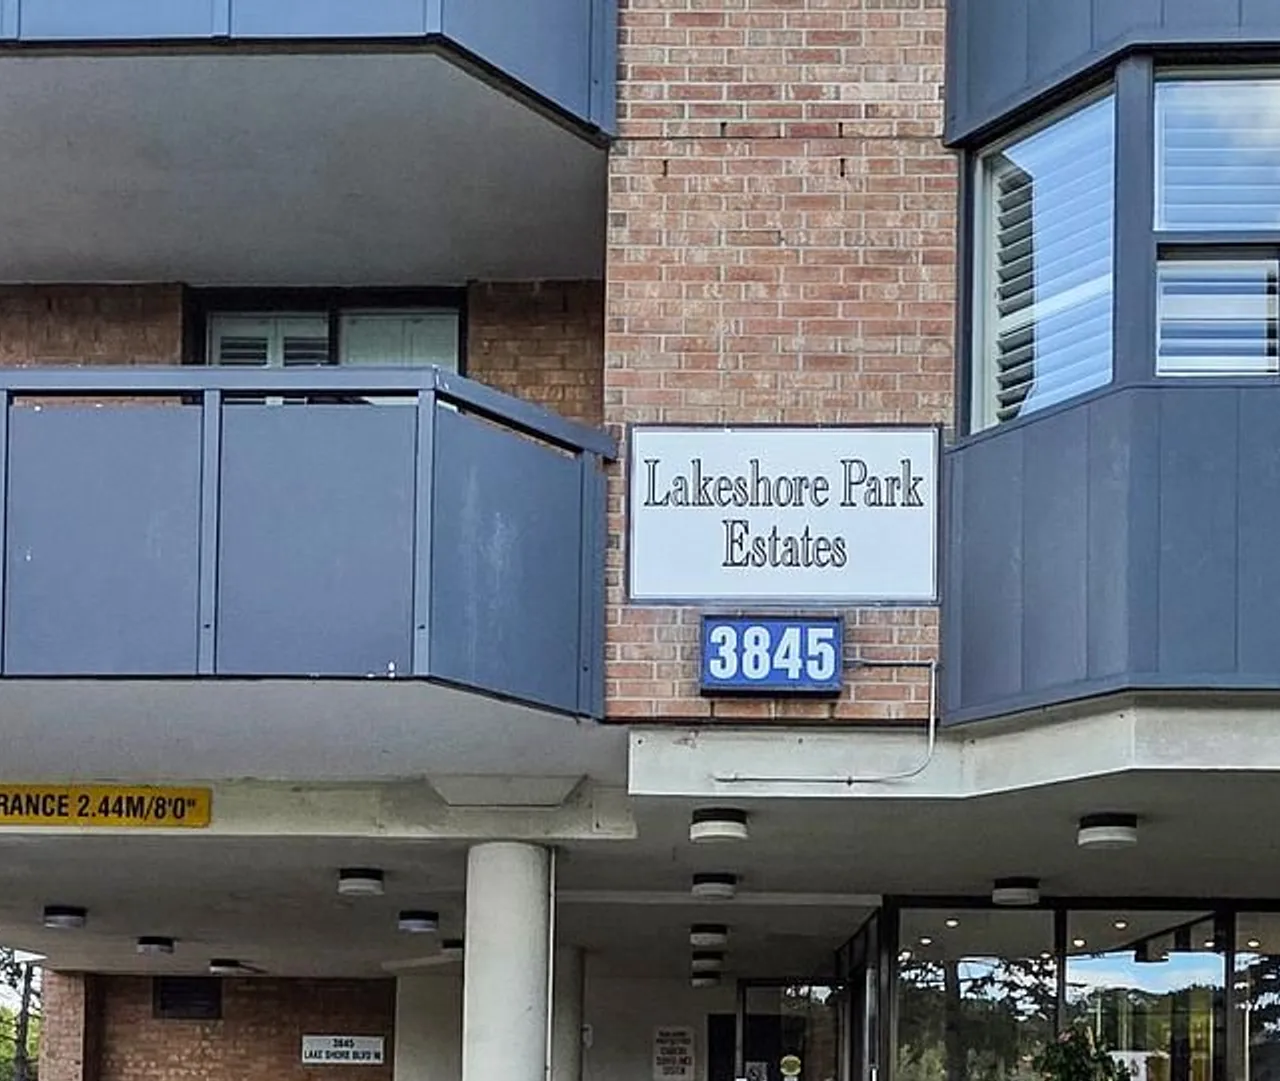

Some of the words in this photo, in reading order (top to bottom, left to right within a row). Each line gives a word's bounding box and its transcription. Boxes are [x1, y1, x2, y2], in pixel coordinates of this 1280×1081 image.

[644, 458, 829, 508] Lakeshore
[839, 458, 925, 508] Park
[722, 518, 848, 568] Estates
[709, 625, 835, 681] 3845
[304, 1050, 323, 1060] LAKE
[325, 1050, 350, 1060] SHORE
[352, 1050, 371, 1060] BLVD
